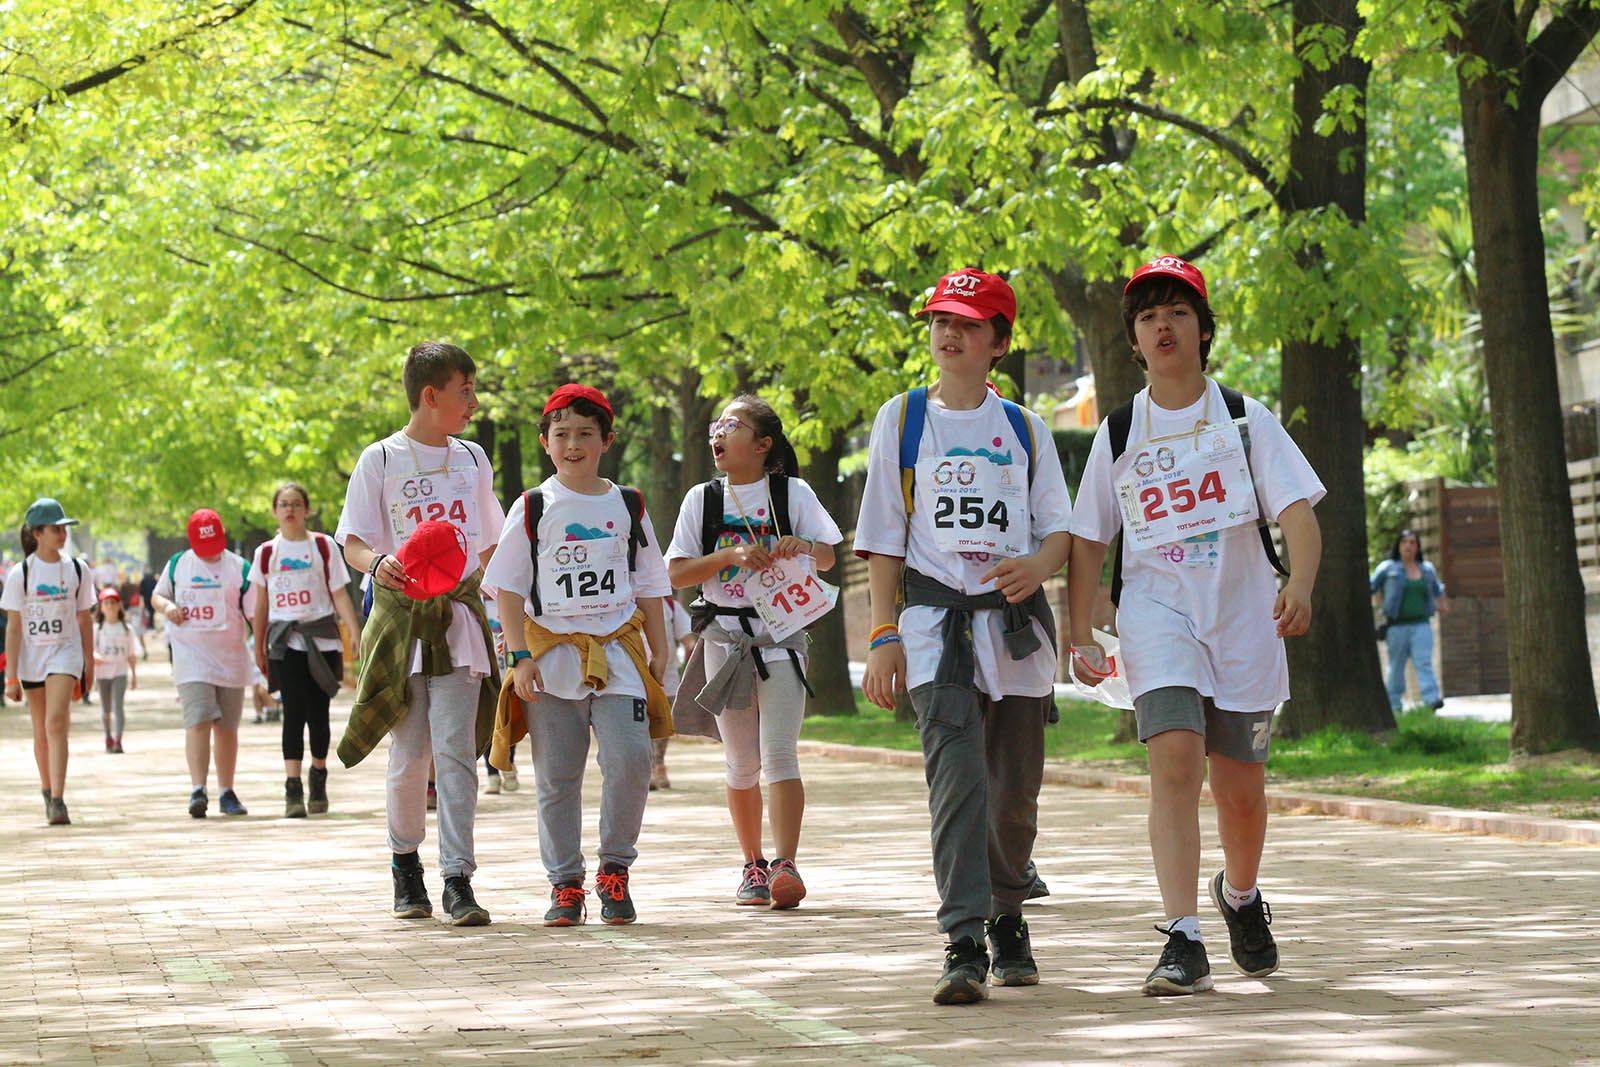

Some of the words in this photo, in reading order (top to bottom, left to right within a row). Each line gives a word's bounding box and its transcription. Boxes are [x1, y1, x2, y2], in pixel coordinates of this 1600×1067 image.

[1149, 257, 1185, 268] TOT
[947, 274, 981, 289] TOT
[933, 461, 976, 486] 60
[1134, 447, 1175, 478] 60
[403, 478, 433, 499] 60
[1140, 470, 1227, 522] 254
[406, 500, 467, 526] 124
[934, 496, 1010, 533] 254
[1177, 523, 1187, 531] TOT
[555, 545, 588, 566] 60
[556, 569, 616, 598] 124
[772, 575, 824, 614] 131
[276, 591, 312, 608] 260
[182, 606, 215, 621] 249
[29, 619, 63, 635] 249
[633, 698, 645, 722] B
